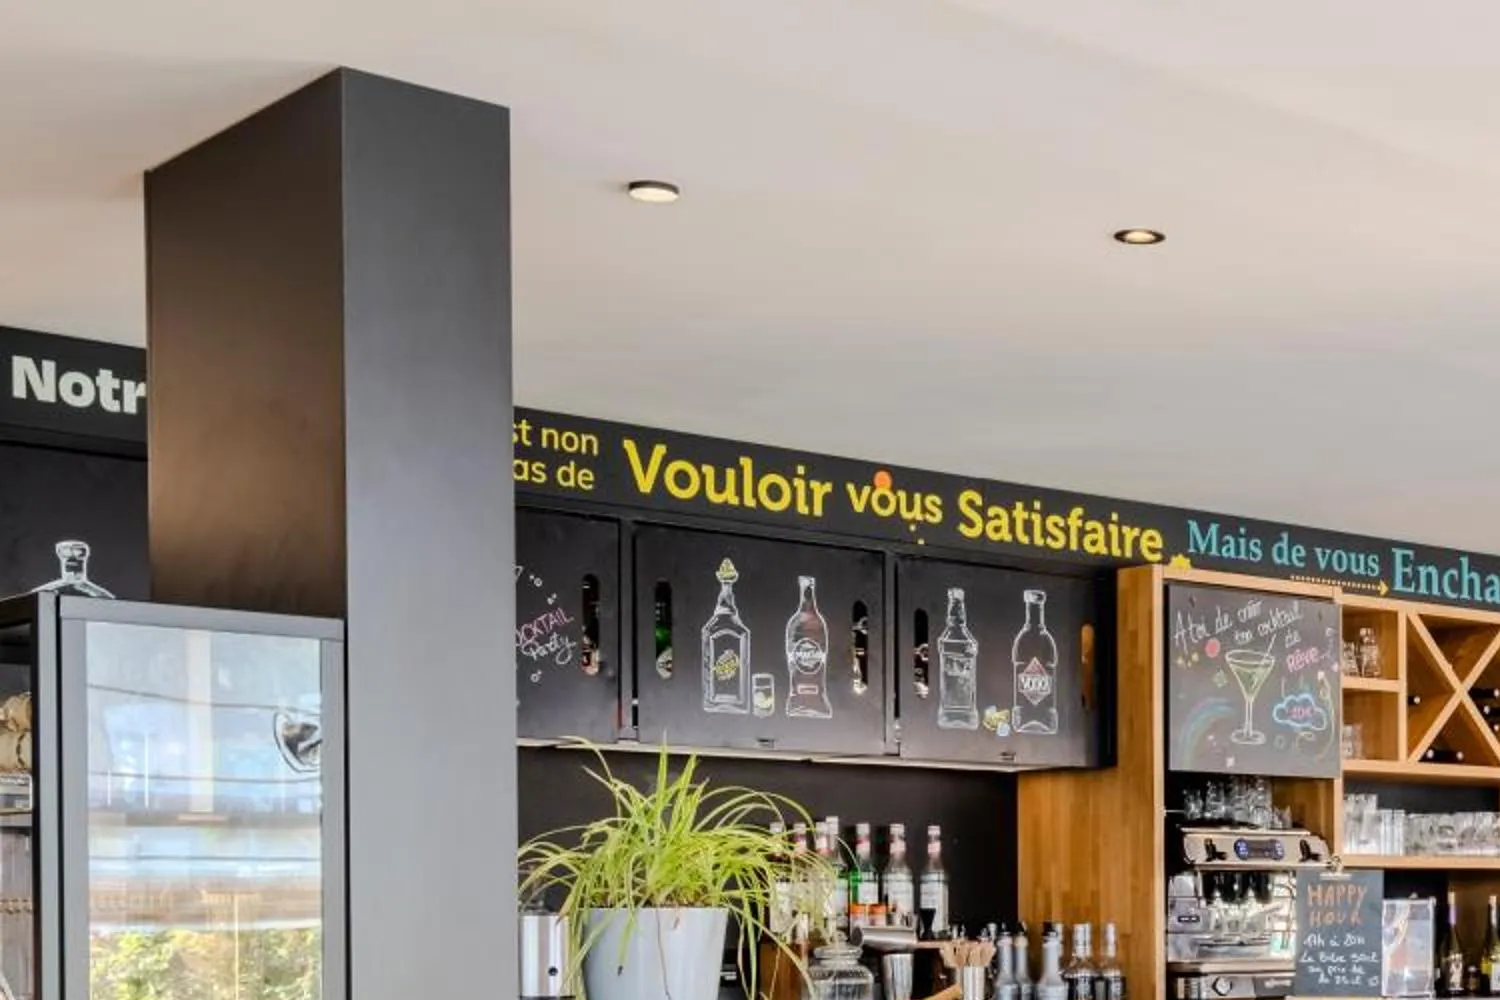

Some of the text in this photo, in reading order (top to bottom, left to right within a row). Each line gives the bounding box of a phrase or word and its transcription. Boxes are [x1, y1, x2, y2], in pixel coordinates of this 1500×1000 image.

[12, 355, 146, 414] Notr
[541, 427, 598, 456] non
[513, 459, 595, 490] as de
[623, 439, 1163, 563] Vouloir vous Satisfaire
[1187, 520, 1263, 563] Mais
[1271, 532, 1306, 568] de
[1313, 547, 1380, 578] vous
[1307, 884, 1367, 908] HAPPY
[1309, 909, 1362, 927] HOUR
